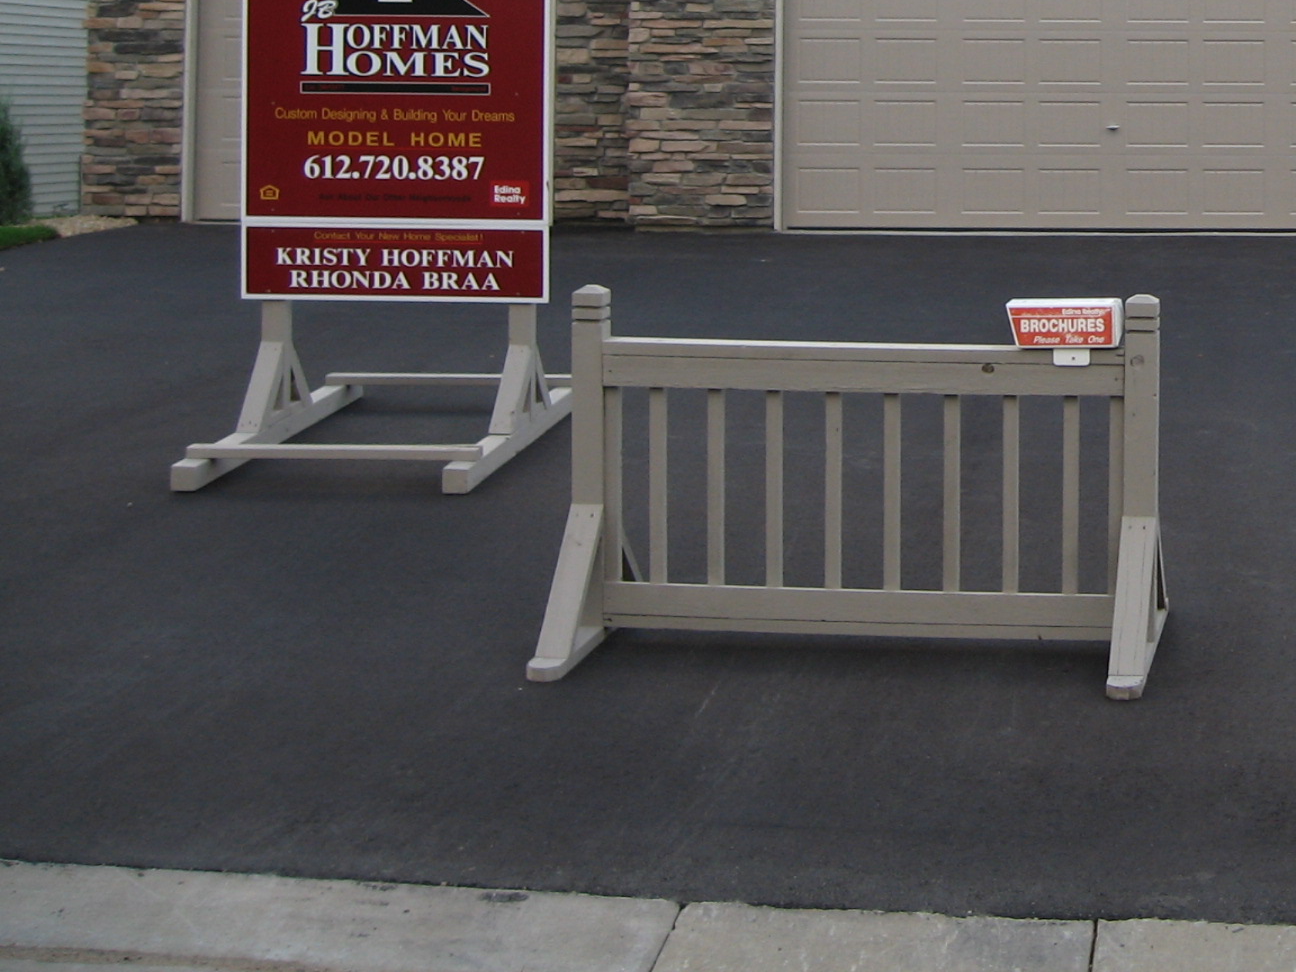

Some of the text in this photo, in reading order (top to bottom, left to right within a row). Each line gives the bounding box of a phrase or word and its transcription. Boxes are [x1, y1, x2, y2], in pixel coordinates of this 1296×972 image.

[301, 23, 489, 75] HOFFMAN
[275, 107, 516, 124] Custom Designing & Building Your Dreams
[307, 131, 482, 147] MODEL HOME
[303, 154, 485, 180] 612.720.8387
[494, 185, 521, 194] Edina
[494, 194, 526, 205] Realty
[314, 231, 351, 240] Contact
[355, 231, 374, 240] Your
[379, 231, 399, 240] New
[404, 232, 431, 241] Home
[276, 247, 514, 268] KRISTY HOFFMAN
[289, 270, 500, 290] RHONDA BRAA
[1020, 318, 1105, 333] BROCHURES
[1033, 334, 1105, 344] Please Take One
